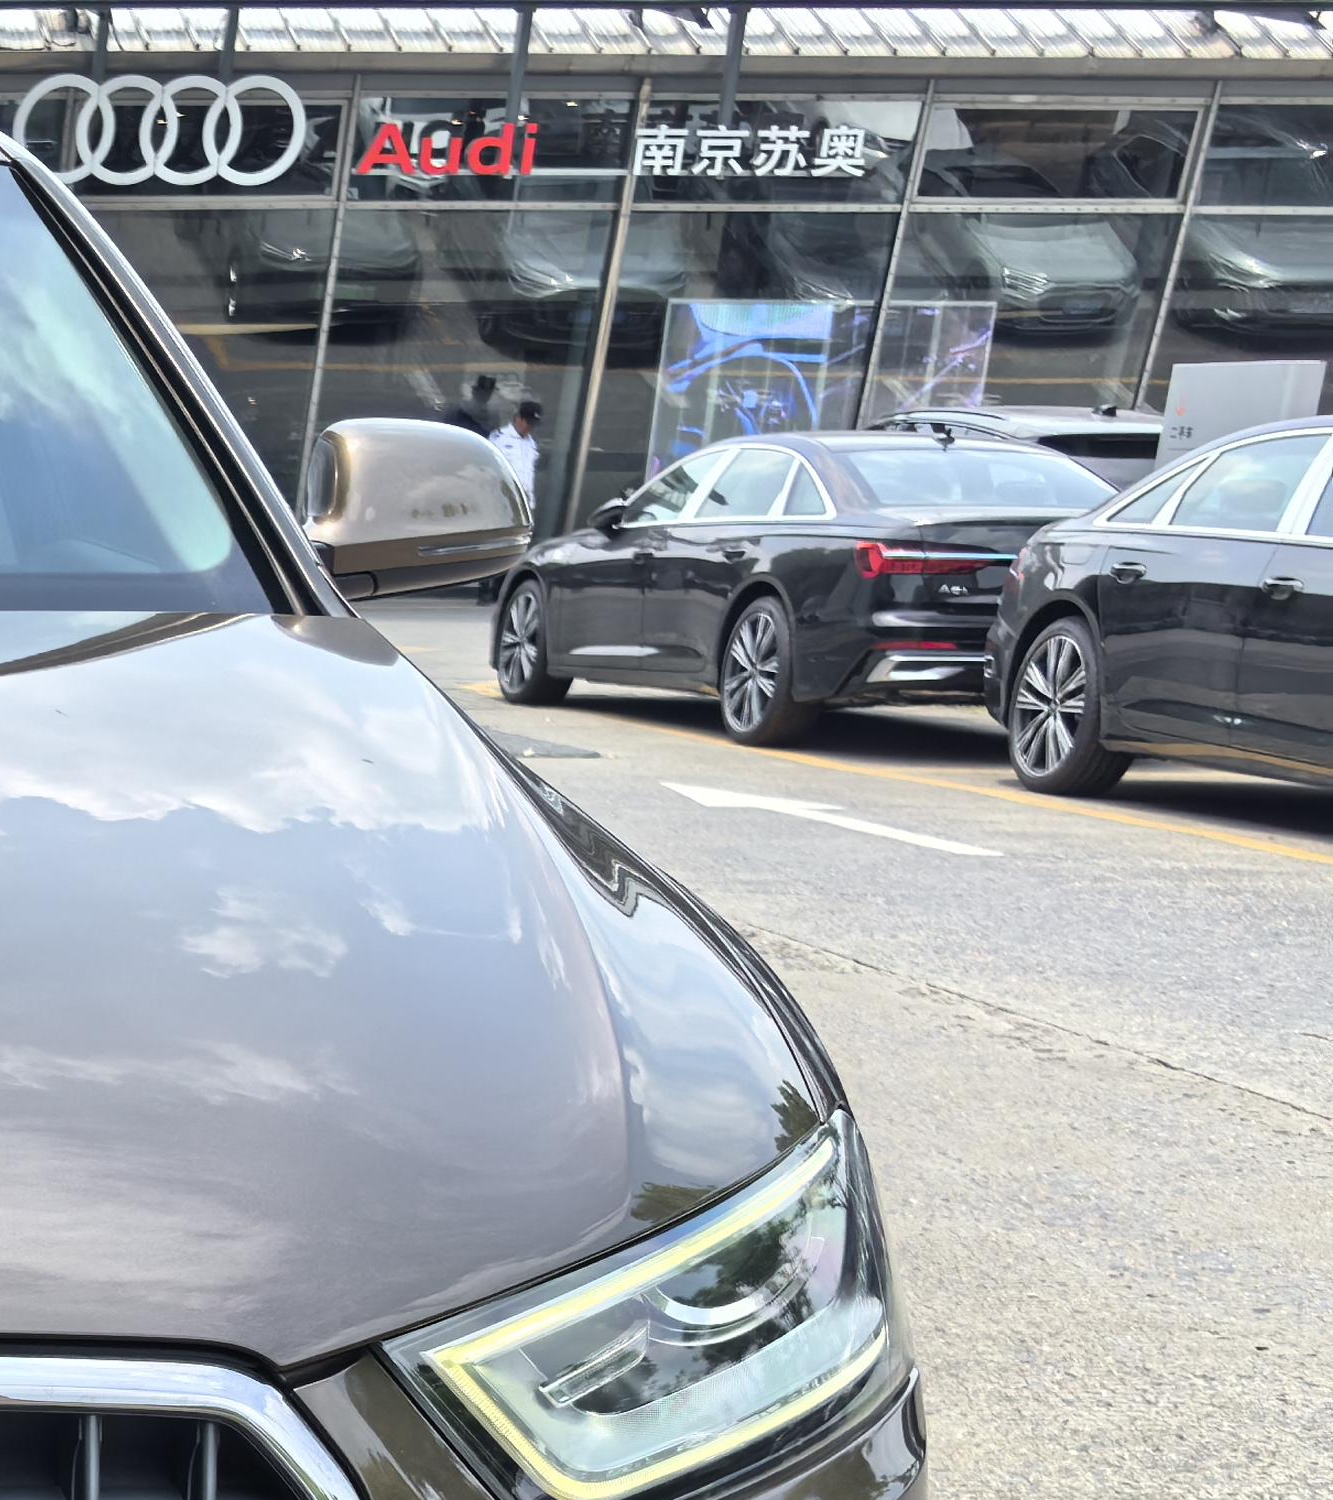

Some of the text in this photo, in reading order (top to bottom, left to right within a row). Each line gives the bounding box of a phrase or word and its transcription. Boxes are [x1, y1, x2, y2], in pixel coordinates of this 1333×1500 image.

[357, 124, 539, 176] Audi
[635, 126, 866, 178] 南京苏奥
